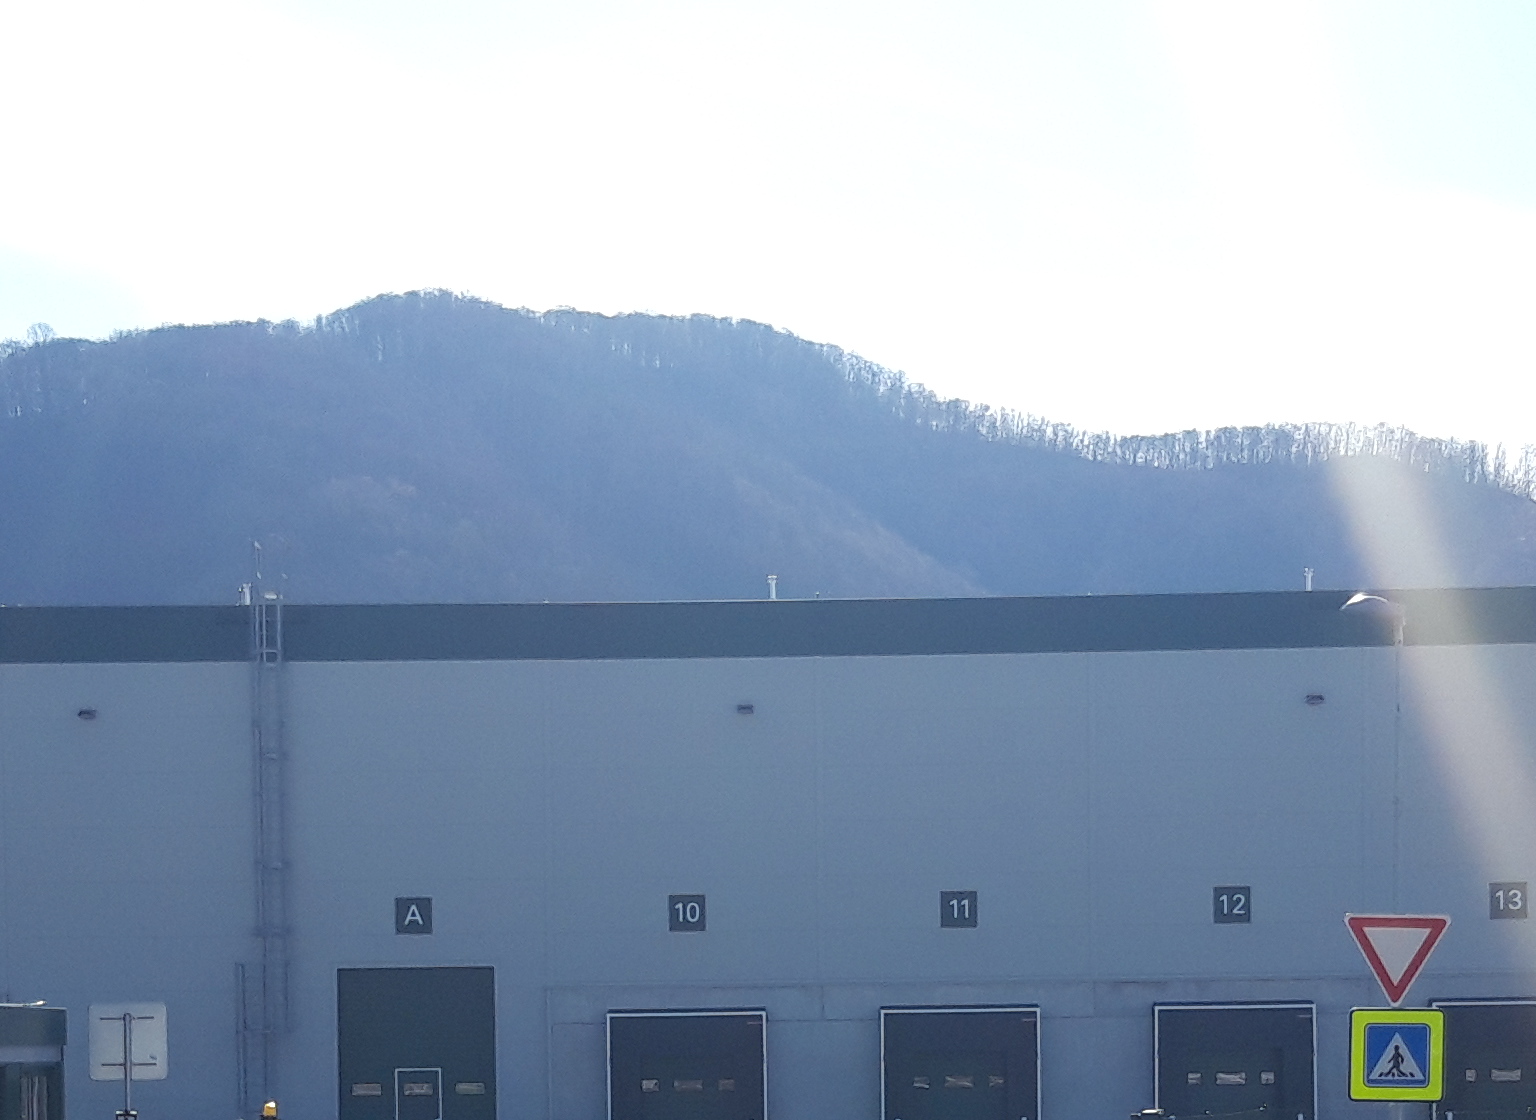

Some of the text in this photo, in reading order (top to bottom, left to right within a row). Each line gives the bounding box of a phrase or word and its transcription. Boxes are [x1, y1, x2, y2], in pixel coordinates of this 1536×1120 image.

[949, 898, 969, 919] 11
[1219, 893, 1246, 915] 12
[1495, 889, 1523, 910] 13
[404, 904, 424, 926] A
[675, 902, 700, 923] 10
